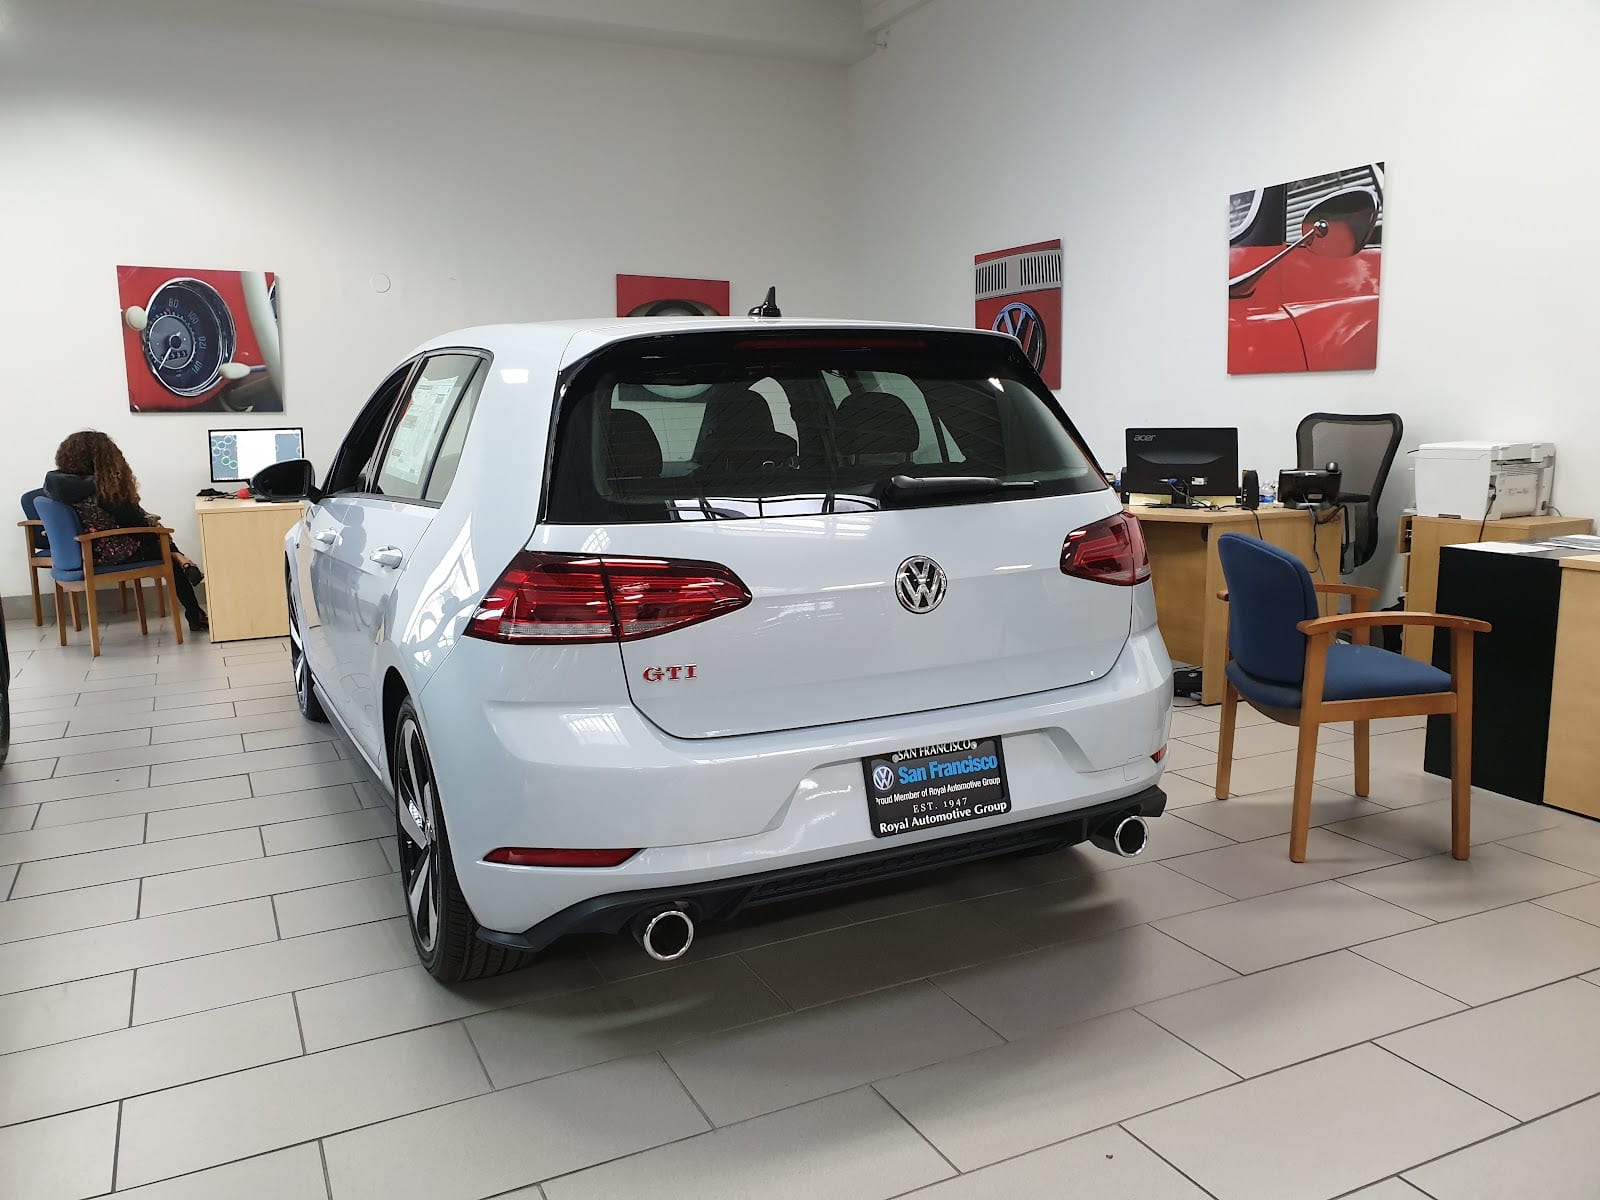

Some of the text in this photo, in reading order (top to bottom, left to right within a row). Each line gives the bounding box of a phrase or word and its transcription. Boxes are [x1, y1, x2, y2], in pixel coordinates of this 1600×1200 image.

[1134, 434, 1156, 442] acer
[643, 664, 697, 682] GTI
[898, 740, 971, 761] SAN FRANCISCO
[897, 755, 998, 785] San Francisco
[894, 790, 920, 803] Member
[921, 788, 928, 798] of
[929, 784, 947, 797] Royal
[947, 781, 982, 793] Automotive
[982, 776, 1000, 787] Group
[912, 797, 968, 814] EST. 1947
[880, 801, 1007, 834] Royal Automotive Group
